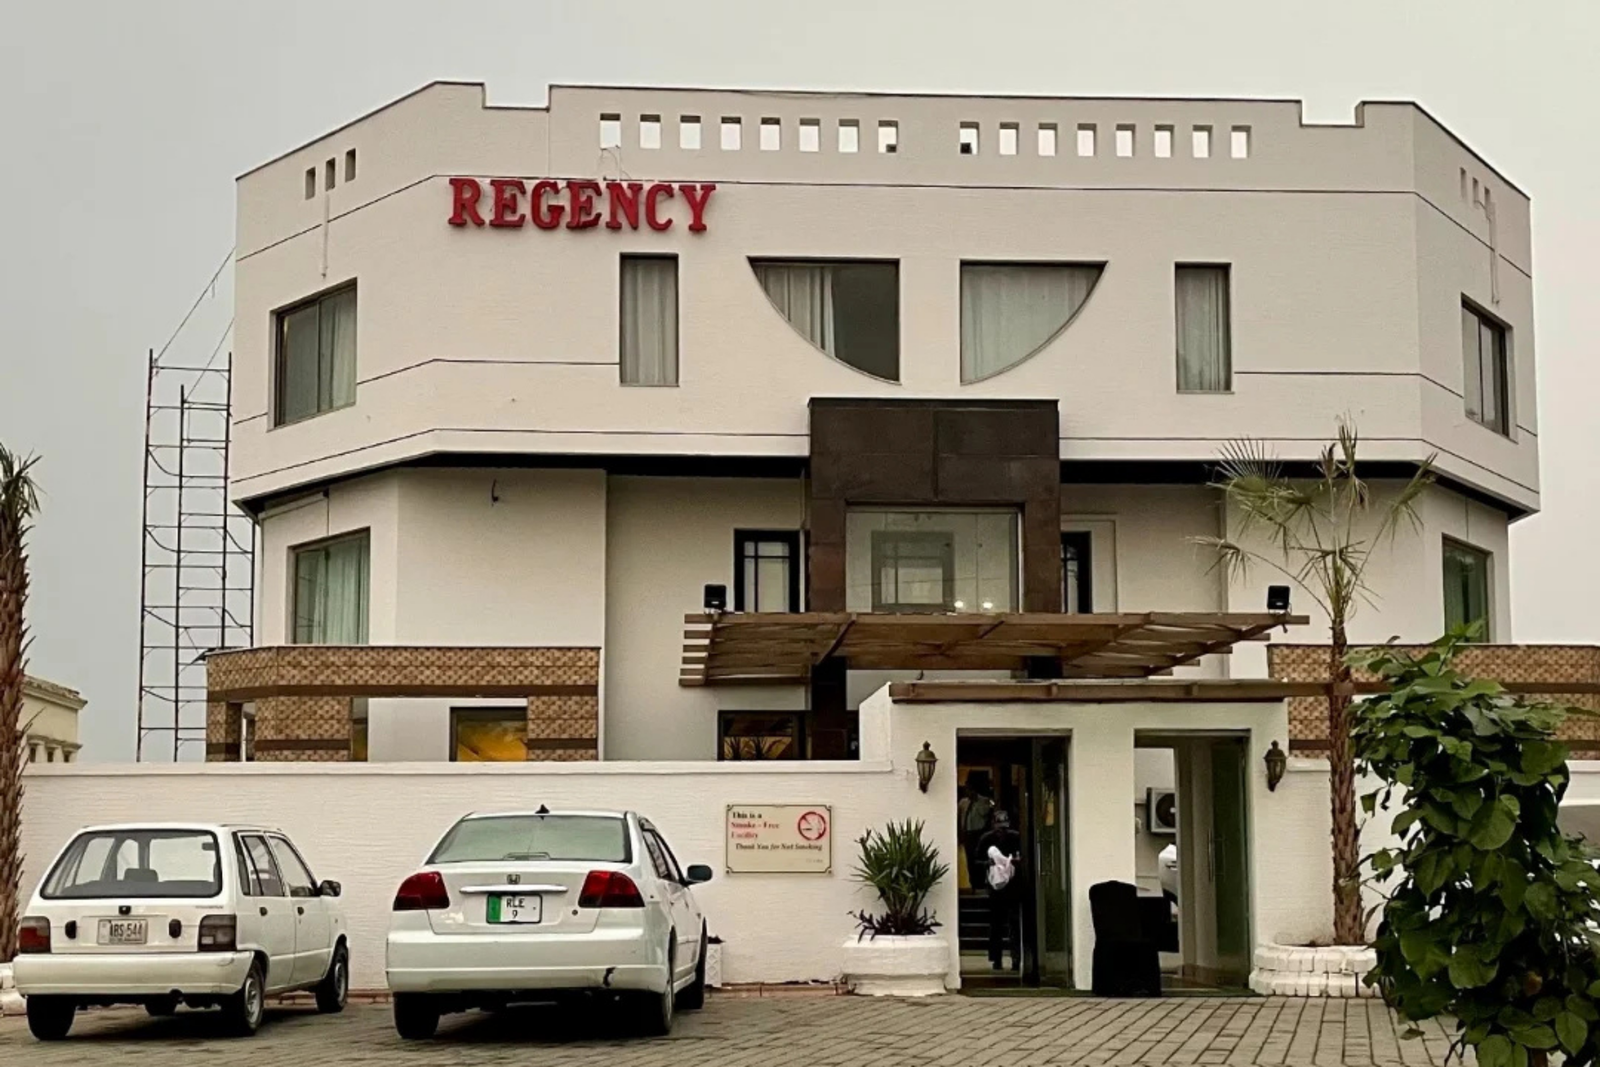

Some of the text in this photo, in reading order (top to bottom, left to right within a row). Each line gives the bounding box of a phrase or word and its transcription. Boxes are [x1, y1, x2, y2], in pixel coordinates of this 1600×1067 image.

[448, 178, 716, 231] REGENCY
[732, 811, 748, 819] This
[506, 897, 525, 908] RLE
[512, 909, 518, 919] 9
